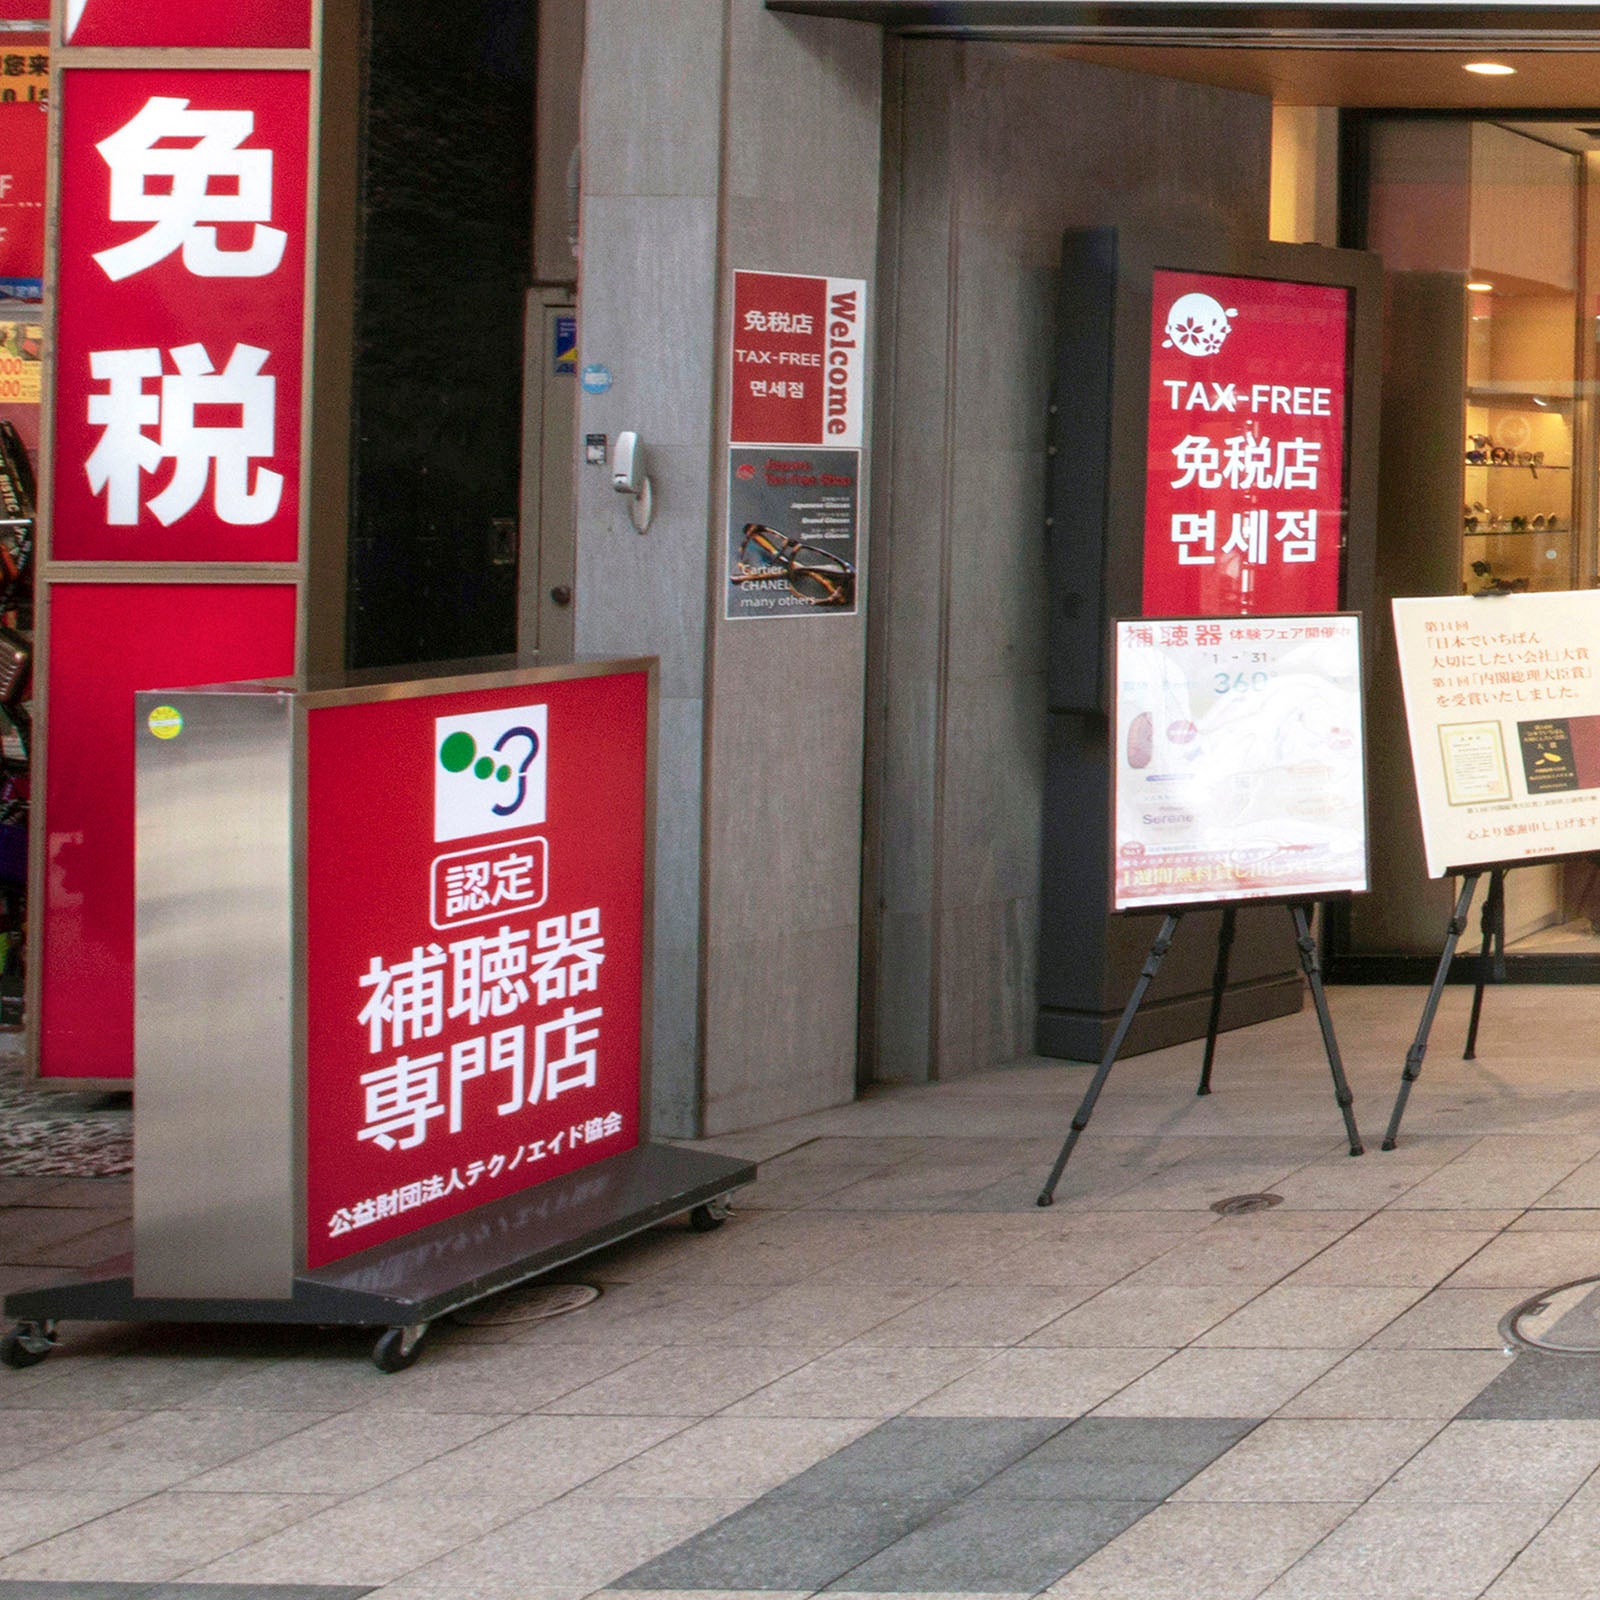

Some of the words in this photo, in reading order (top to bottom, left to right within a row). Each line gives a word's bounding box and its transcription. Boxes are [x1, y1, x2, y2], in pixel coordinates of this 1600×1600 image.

[84, 95, 288, 528] 免税
[744, 310, 814, 335] 免税店
[735, 349, 822, 367] TAX-FREE
[828, 290, 857, 435] Welcome
[750, 380, 805, 399] 면세점
[1163, 379, 1332, 417] TAX-FREE
[1170, 434, 1320, 493] 免税店
[1171, 509, 1318, 566] 면세점
[740, 598, 774, 609] many
[778, 596, 815, 606] others
[741, 580, 790, 591] CHANEL
[1427, 632, 1541, 649] 「日本でいちばん
[1432, 647, 1589, 668] 大切にしたい会社」大賞
[1437, 686, 1580, 708] を受賞いたしました。
[444, 852, 536, 919] 認定
[356, 905, 606, 1055] 補聴器
[356, 1005, 604, 1153] 専門店
[327, 1110, 624, 1239] 公益財団法人テクノエイド協会
